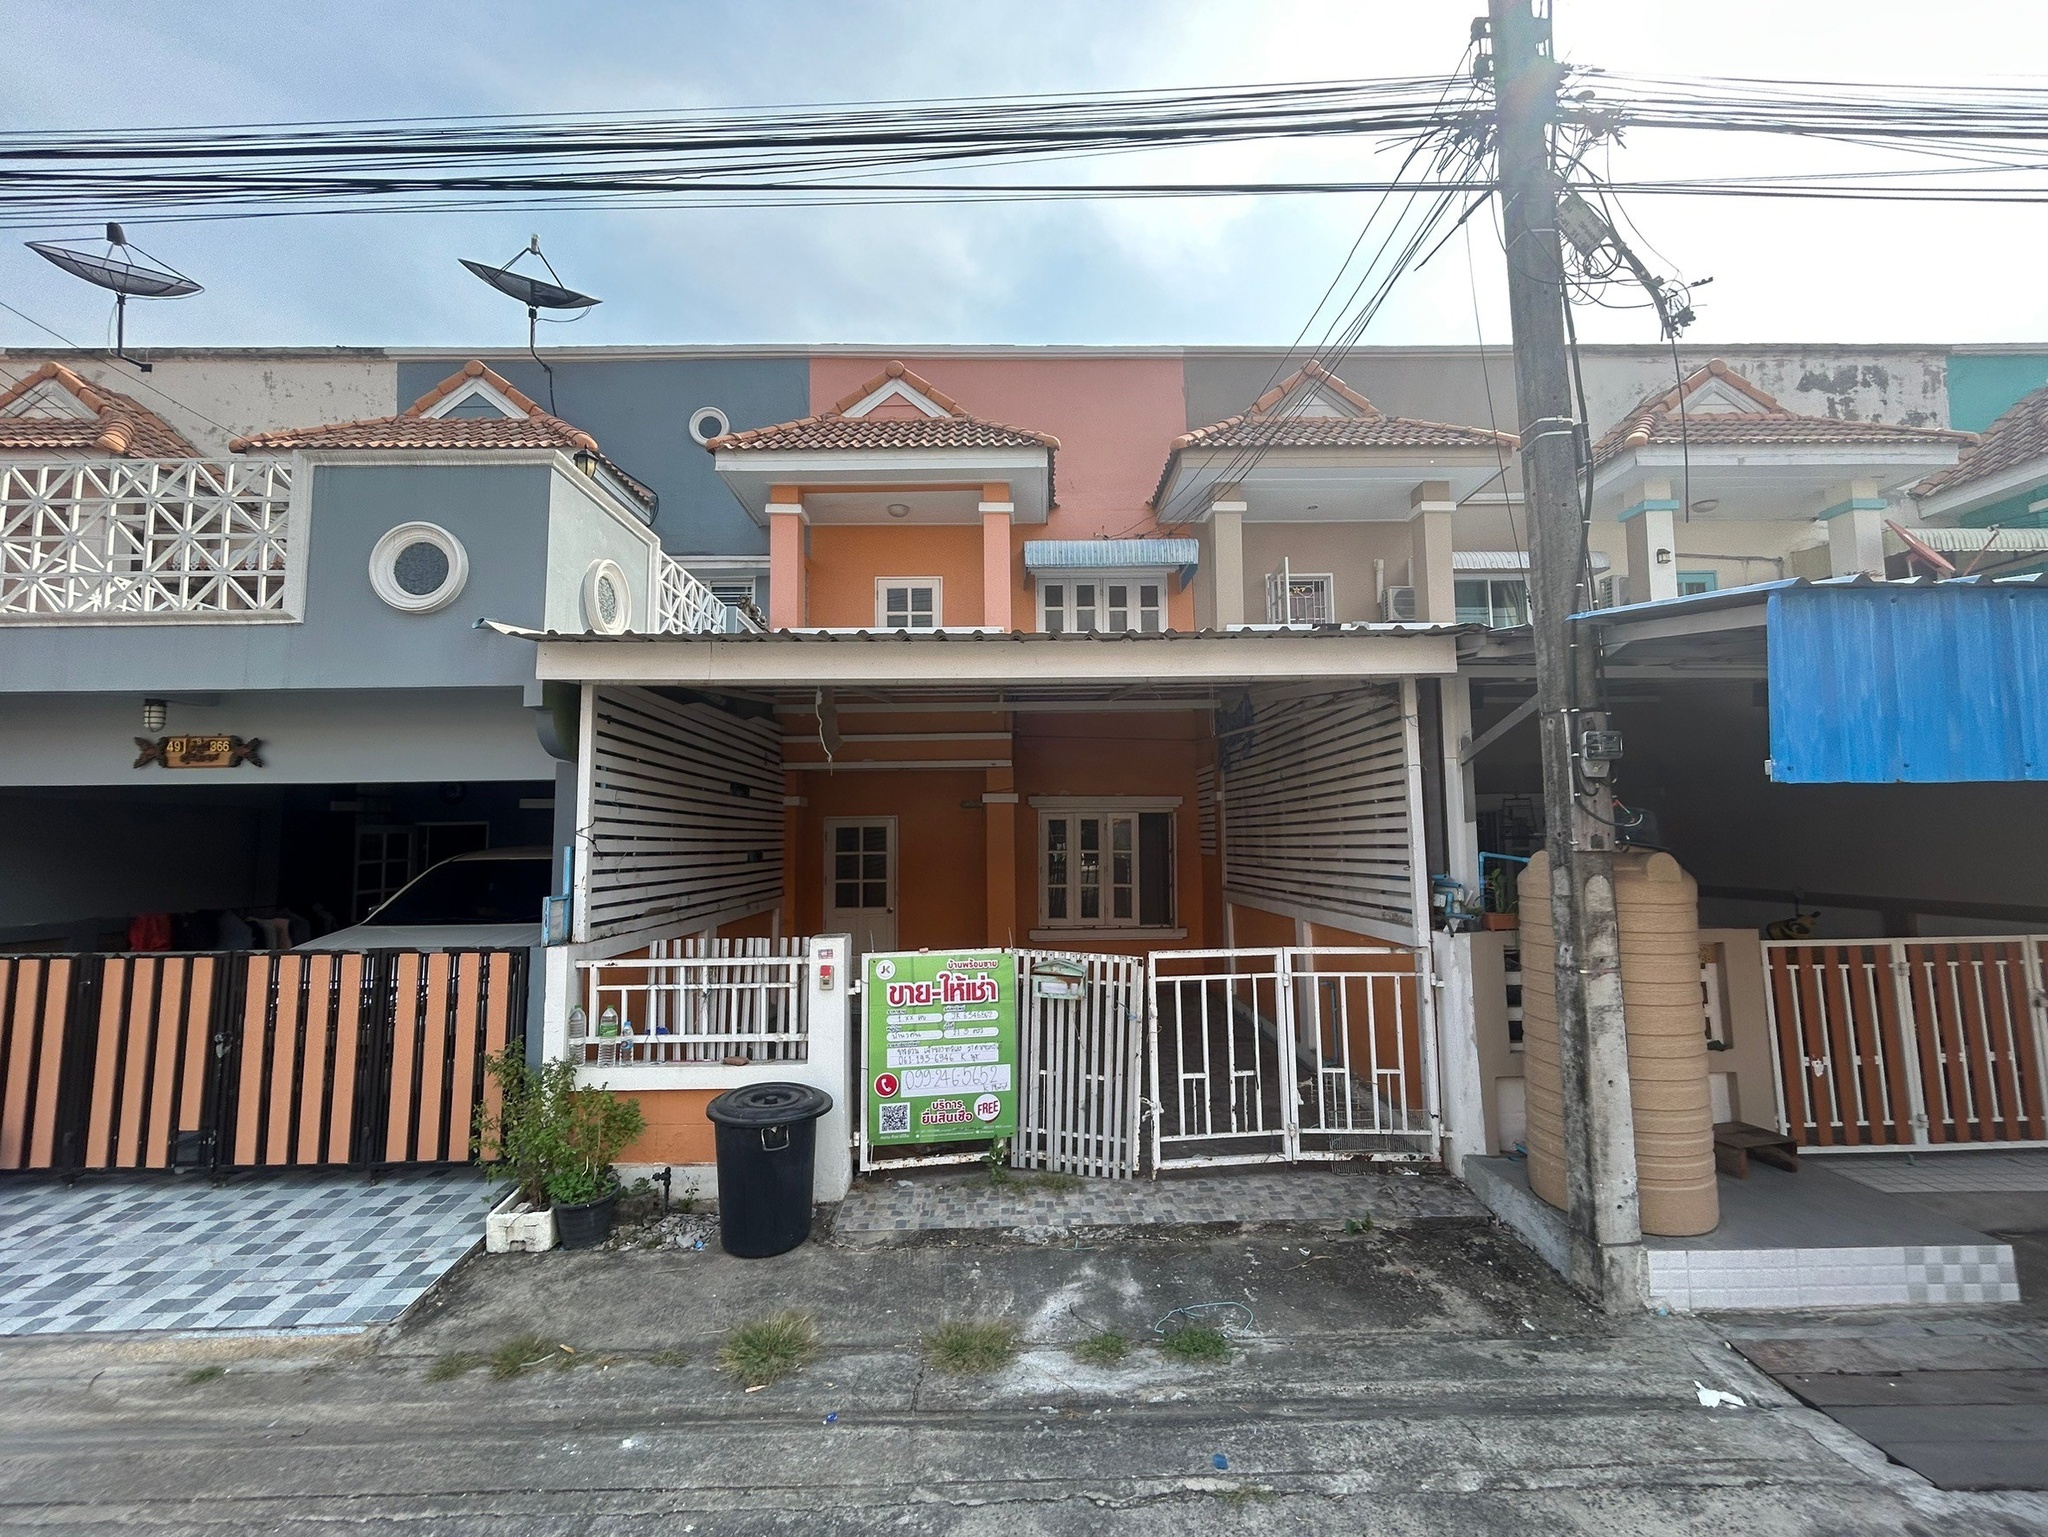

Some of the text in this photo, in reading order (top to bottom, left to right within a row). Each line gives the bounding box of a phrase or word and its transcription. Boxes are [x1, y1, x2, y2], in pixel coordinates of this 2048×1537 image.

[889, 973, 997, 1005] ขาย-ให้เช่า
[932, 1100, 963, 1110] บริการ
[977, 1101, 999, 1115] FREE
[922, 1107, 973, 1124] ยื่นสินเชื่อ
